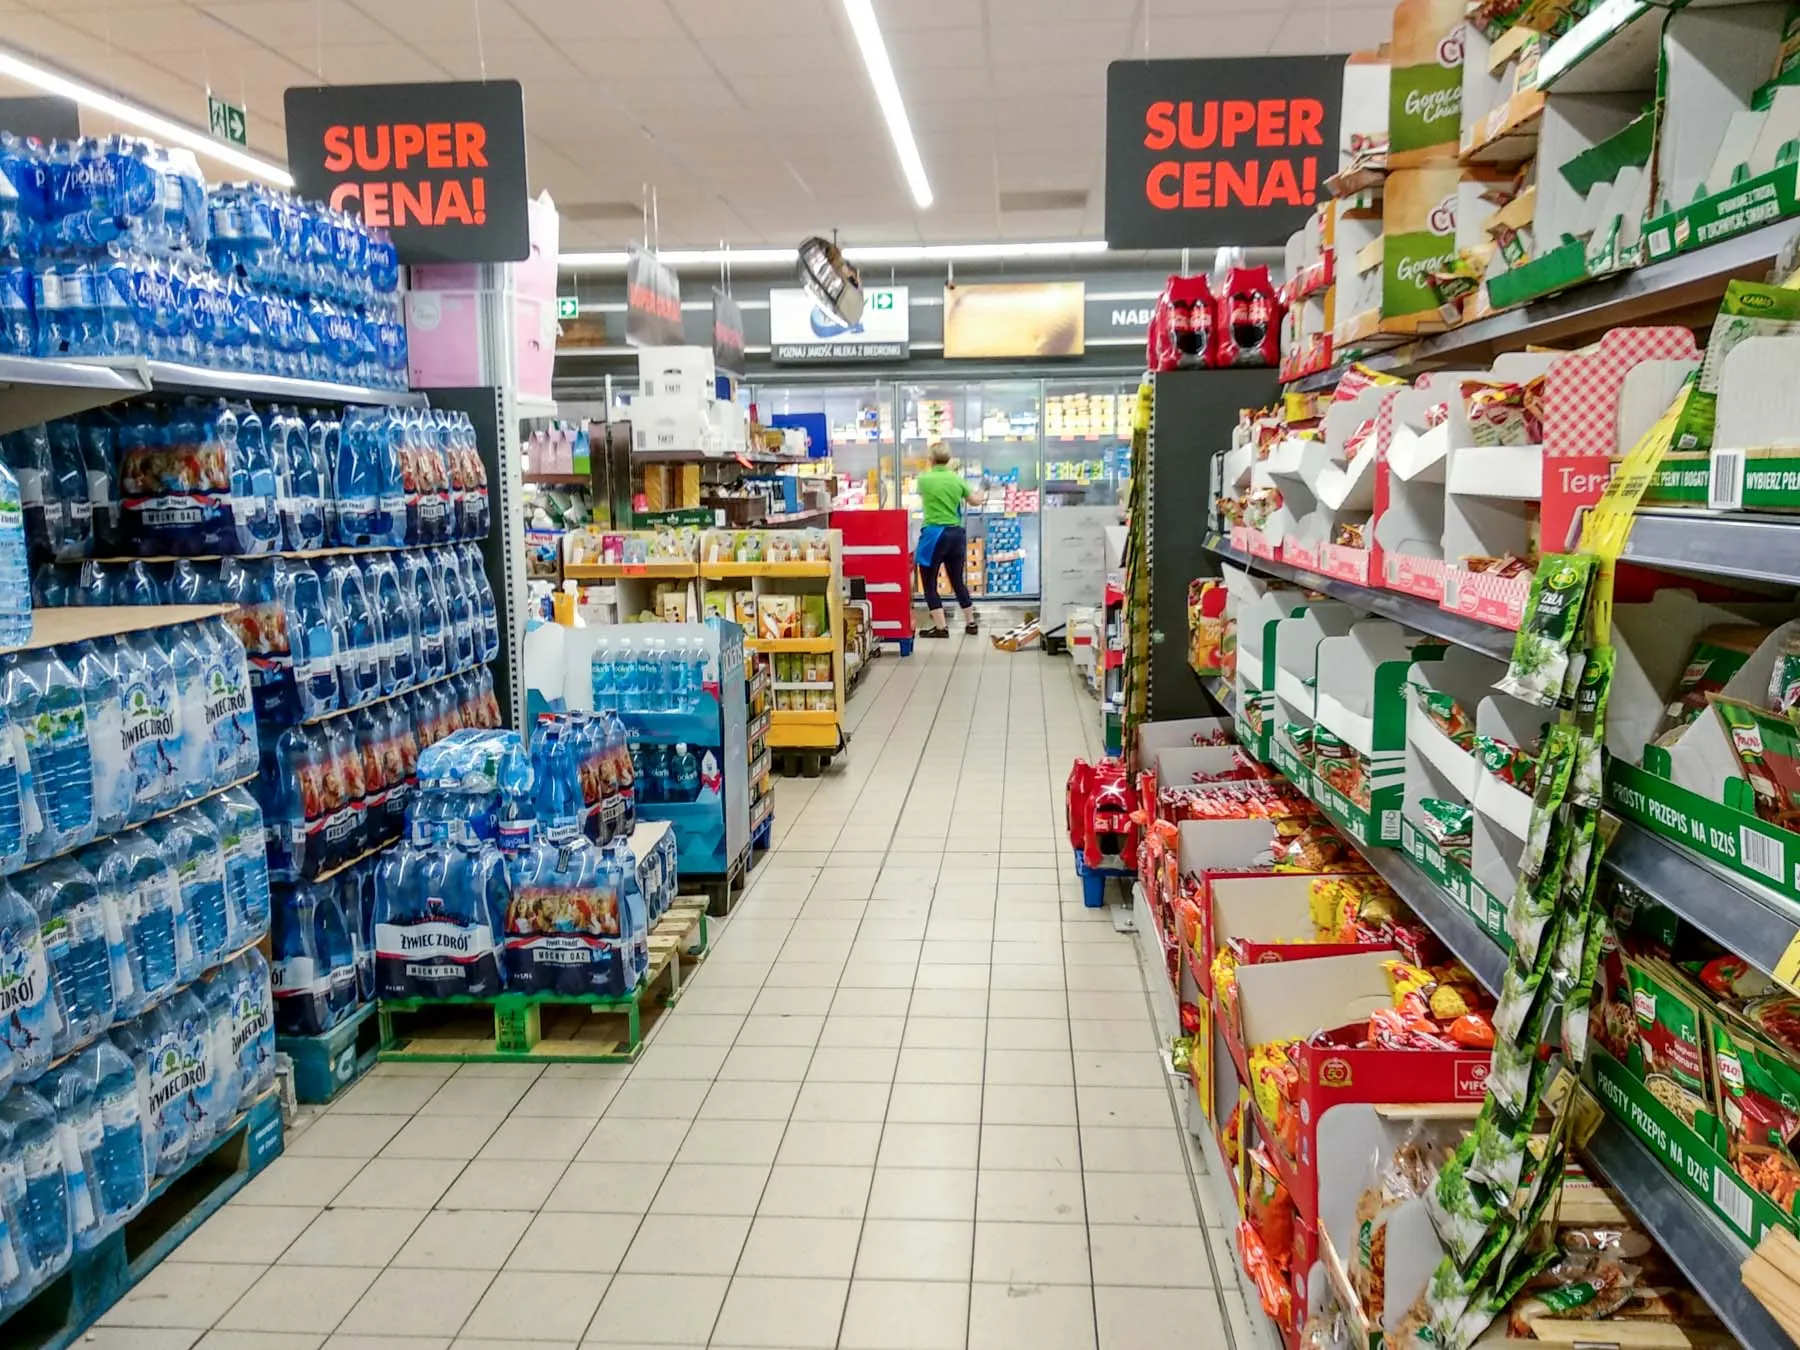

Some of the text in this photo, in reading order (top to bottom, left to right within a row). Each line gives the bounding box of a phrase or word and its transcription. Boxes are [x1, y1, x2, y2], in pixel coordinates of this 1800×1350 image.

[1144, 98, 1324, 150] SUPER
[323, 122, 489, 172] SUPER
[330, 177, 486, 227] CENA!
[1146, 156, 1317, 210] CENA!
[1746, 472, 1781, 490] WYBIERZ
[1612, 781, 1736, 858] PROSTY PRZEPIS NA DZIŚ
[400, 932, 469, 952] ŻYWIEC ZDRÓJ
[538, 950, 585, 961] MOCNY GAZ
[411, 965, 439, 976] MOCNY
[1681, 1024, 1696, 1045] Fix
[1665, 1043, 1699, 1072] Carbonara
[1598, 1071, 1710, 1193] PROSTY PRZEPIS NA DZIŚ
